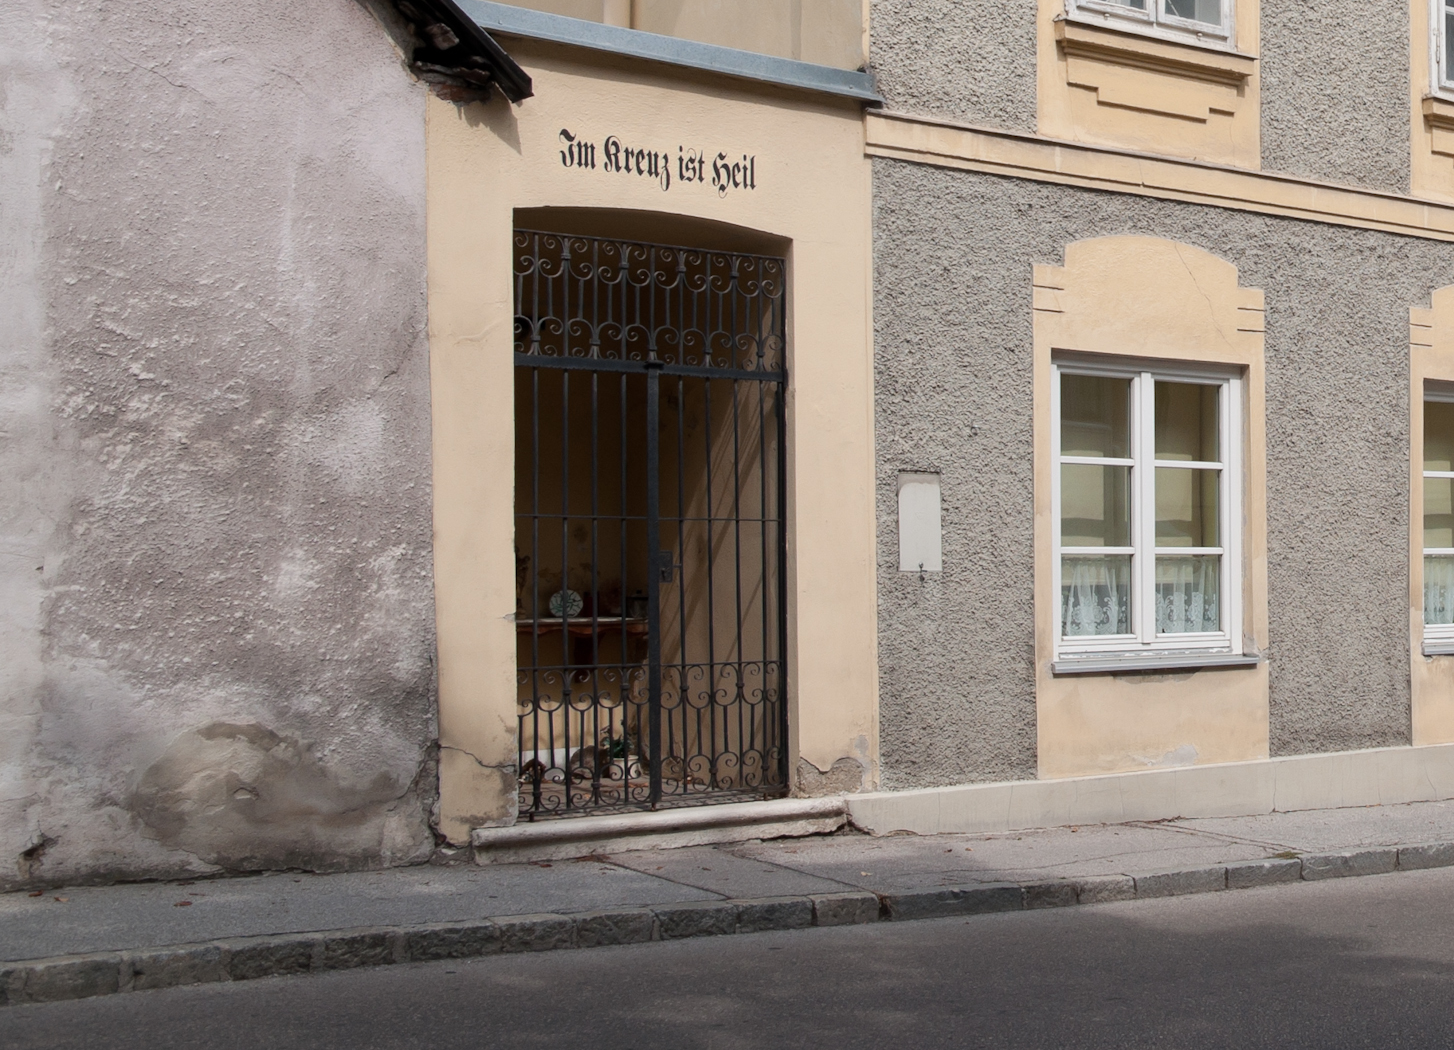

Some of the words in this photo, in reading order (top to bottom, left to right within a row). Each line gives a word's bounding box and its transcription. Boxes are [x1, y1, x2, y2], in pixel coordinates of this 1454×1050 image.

[559, 128, 596, 169] Im
[604, 135, 671, 191] Kreuz
[678, 145, 705, 183] ist
[712, 152, 757, 198] Heil
